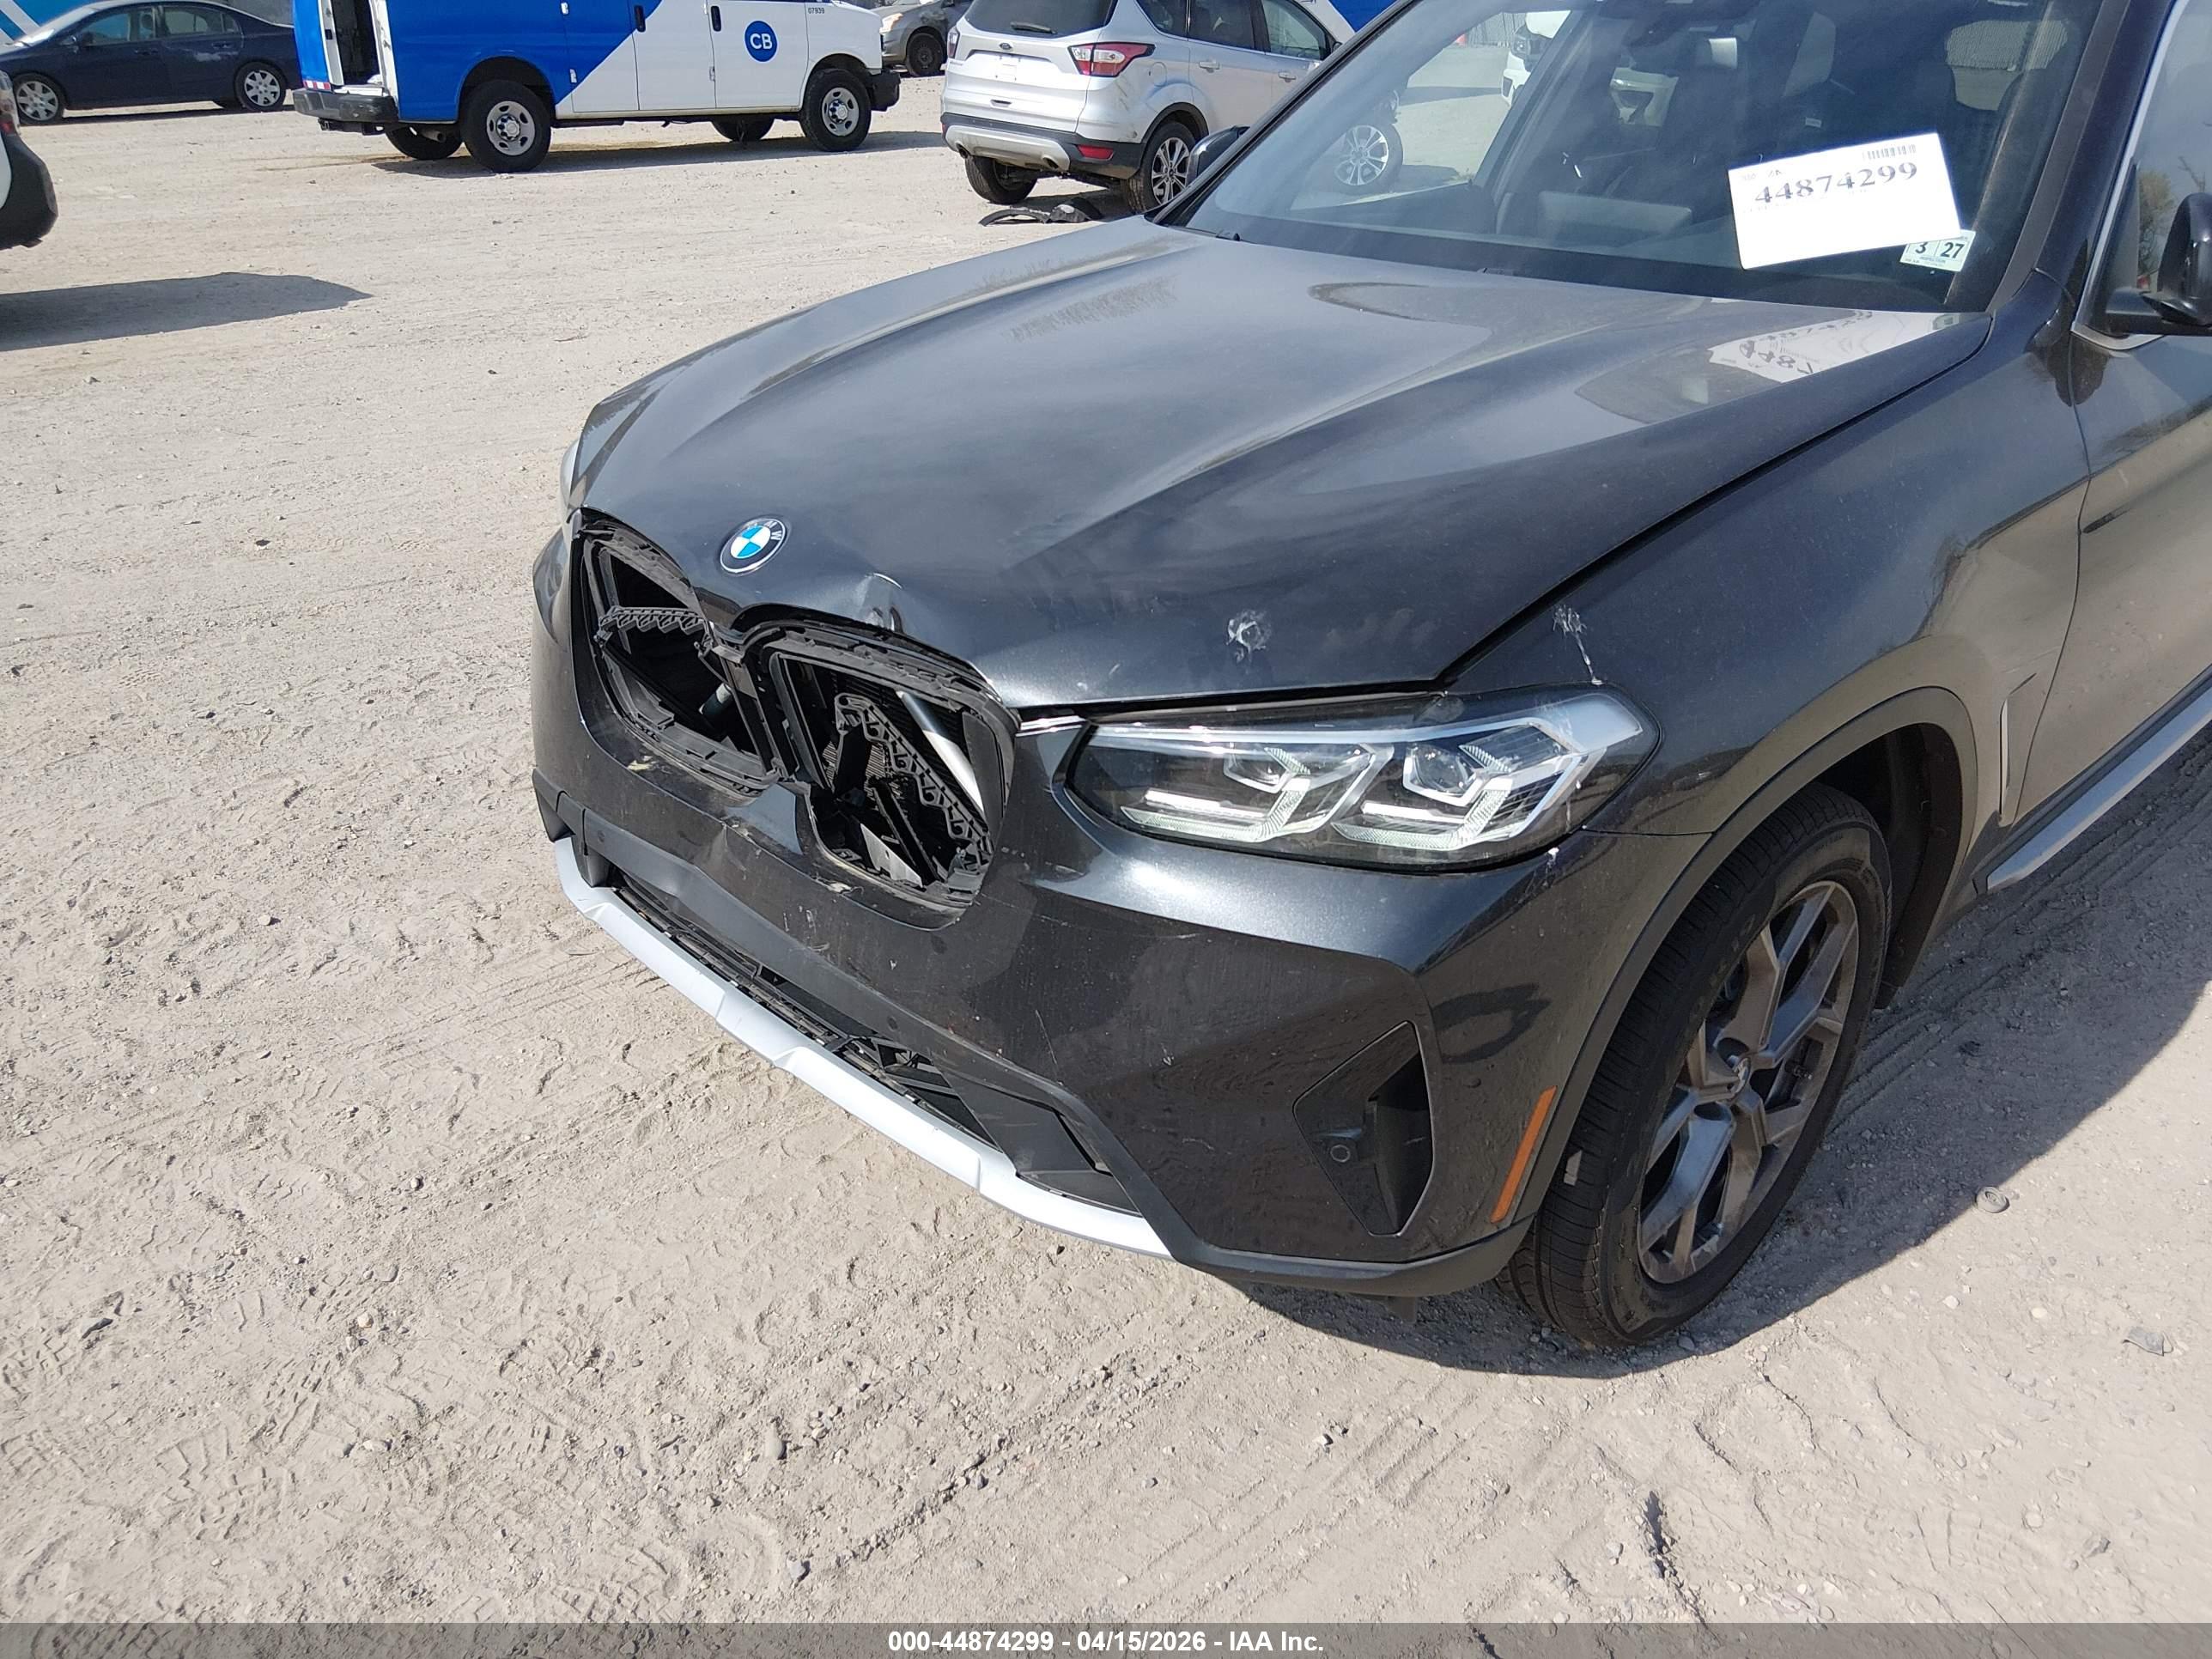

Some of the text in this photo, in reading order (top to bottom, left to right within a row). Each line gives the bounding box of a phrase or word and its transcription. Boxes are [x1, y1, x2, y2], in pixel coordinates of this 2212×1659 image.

[750, 33, 773, 50] CB
[1754, 161, 1918, 203] 44874299
[1915, 241, 1966, 258] 3 27
